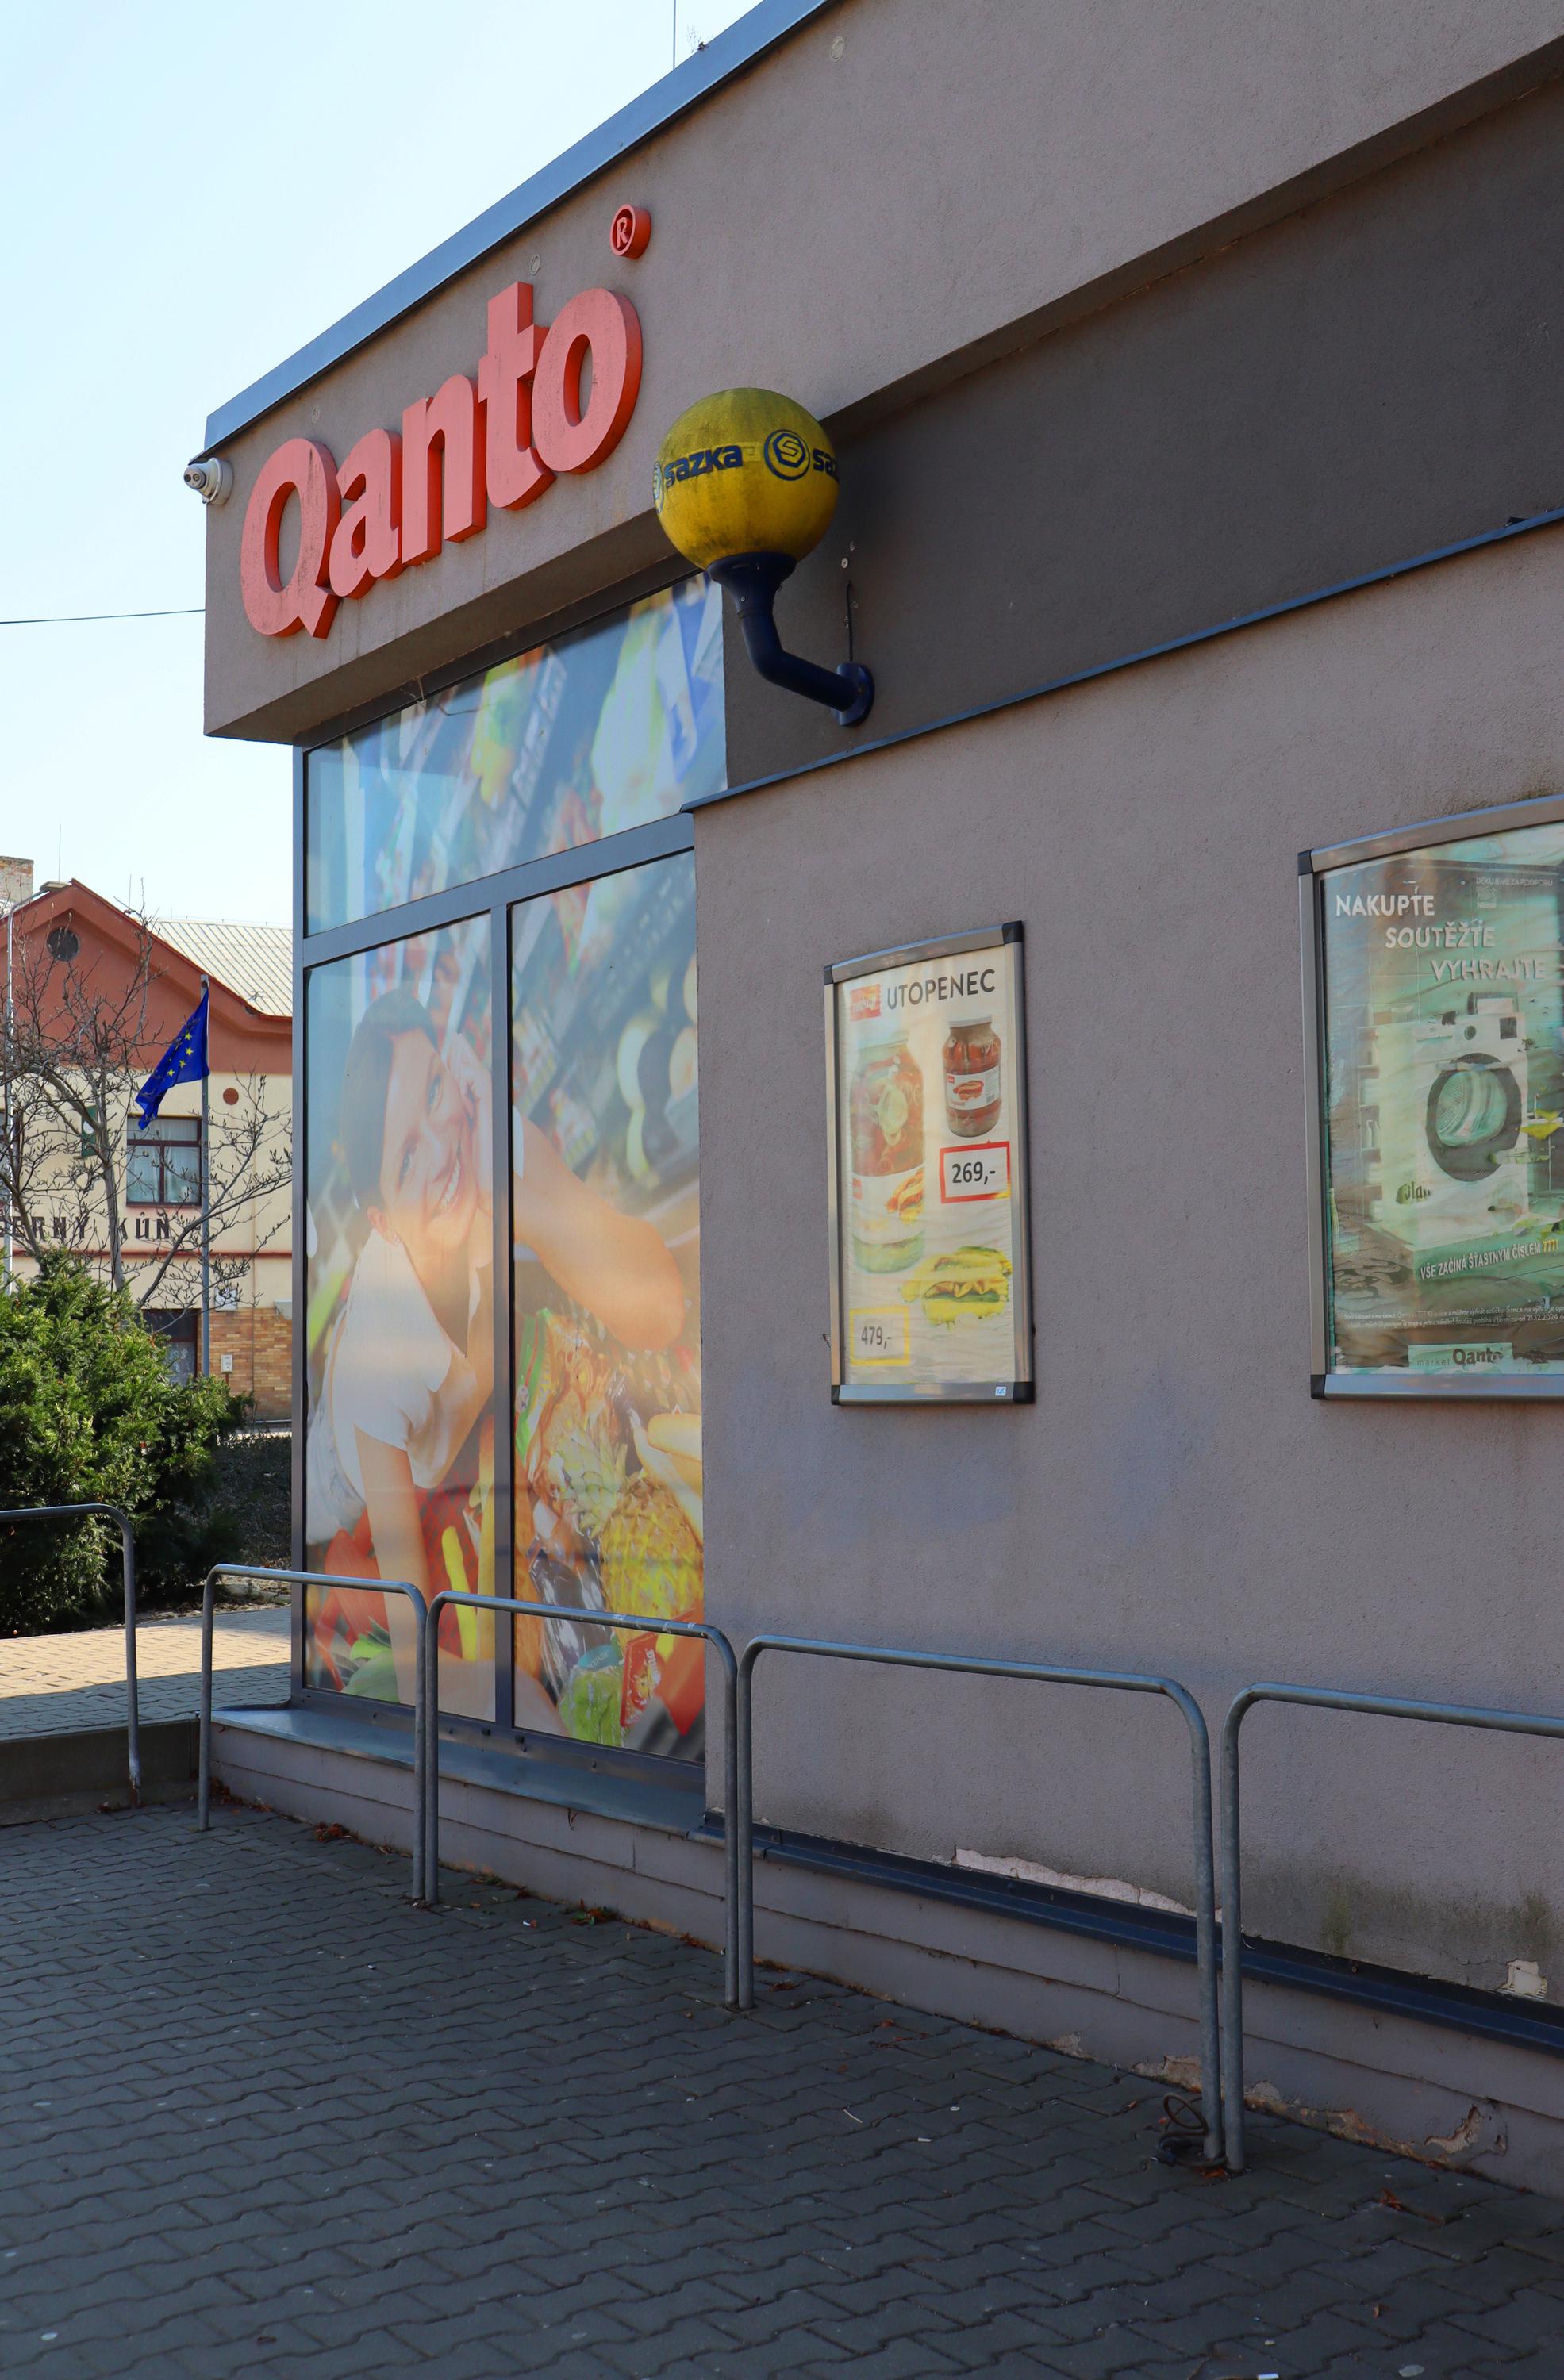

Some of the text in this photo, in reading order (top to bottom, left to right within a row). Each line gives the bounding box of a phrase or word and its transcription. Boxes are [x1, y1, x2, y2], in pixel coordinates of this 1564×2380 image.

[240, 282, 642, 639] Qanto
[663, 444, 744, 489] sazka
[813, 448, 837, 480] sa
[1430, 959, 1545, 981] VYHRAJTE
[887, 969, 996, 1010] UTOPENEC
[952, 1161, 996, 1185] 269,-
[1420, 1263, 1435, 1280] VŠE
[1438, 1256, 1466, 1276] ZAČÍNÁ
[1468, 1246, 1510, 1269] ŠŤASTNÝM
[1512, 1242, 1540, 1259] ČÍSLEM
[861, 1326, 892, 1349] 479,-
